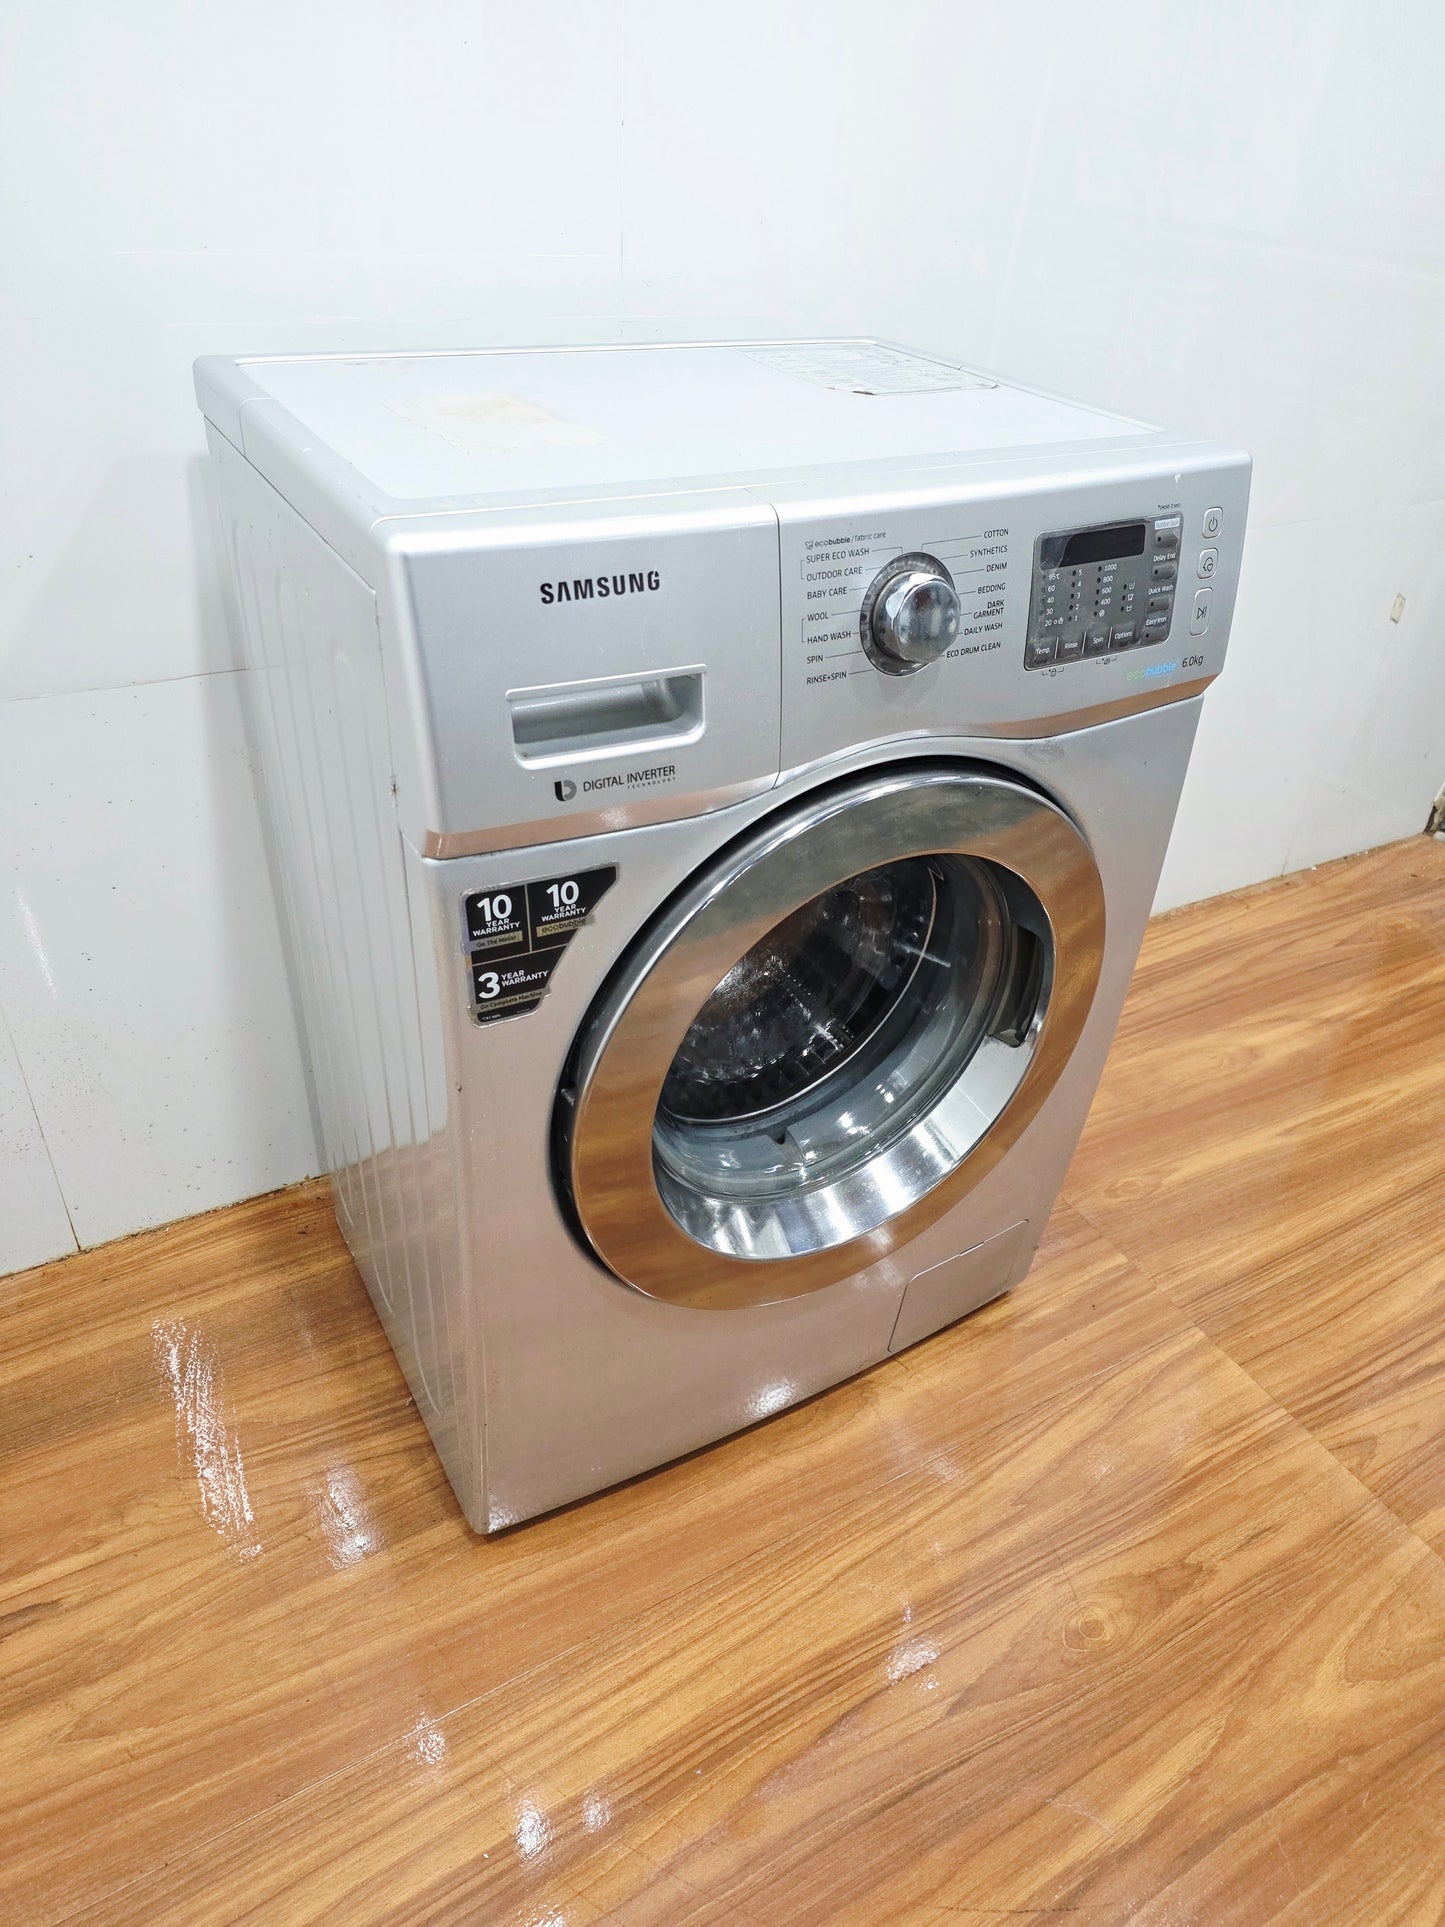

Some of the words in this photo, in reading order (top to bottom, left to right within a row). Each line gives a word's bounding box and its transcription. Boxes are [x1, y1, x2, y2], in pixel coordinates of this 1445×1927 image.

[983, 528, 1009, 539] COTTON
[806, 552, 830, 564] SUPER
[832, 550, 847, 560] ECO
[848, 547, 870, 558] WASH
[970, 545, 1008, 558] SYNTHETICS
[1153, 554, 1166, 562] Delay
[1167, 552, 1176, 560] End
[806, 569, 843, 581] OUTDOOR
[844, 566, 863, 577] CARE
[986, 562, 1008, 572] DENIM
[1104, 563, 1118, 571] 1000
[1102, 575, 1113, 583] 800
[540, 570, 661, 605] SAMSUNG
[807, 589, 827, 600] BABY
[828, 586, 848, 597] CARE
[977, 583, 1006, 594] BEDDING
[1148, 586, 1161, 595] Quick
[1161, 584, 1174, 592] Wash
[987, 599, 1005, 609] DARK
[1046, 596, 1055, 604] 40
[807, 611, 829, 622] WOOL
[973, 607, 1004, 619] GARMENT
[1046, 608, 1054, 616] 30
[964, 625, 983, 636] DAILY
[984, 622, 1003, 632] WASH
[1114, 631, 1133, 640] Options
[807, 634, 829, 644] HAND
[830, 630, 852, 641] WASH
[946, 649, 959, 658] ECO
[960, 645, 980, 656] DRUM
[980, 641, 1001, 652] CLEAN
[806, 655, 824, 664] SPIN
[1126, 661, 1177, 680] ecobubble
[1181, 655, 1204, 668] 6.0kg
[583, 775, 624, 792] DIGITAL
[626, 765, 676, 784] INVERTER
[627, 776, 677, 789] TECHNOLOGY
[546, 880, 580, 907] 10
[476, 894, 513, 922] 10
[541, 906, 587, 922] WARRANTY
[554, 904, 577, 913] YEAR
[472, 921, 521, 937] WARRANTY
[486, 918, 511, 928] YEAR
[541, 917, 587, 933] ecobubble
[486, 938, 497, 946] The
[498, 934, 517, 943] Motor
[501, 969, 525, 980] YEAR
[501, 970, 549, 987] WARRANTY
[477, 971, 501, 999] 3
[489, 997, 518, 1008] Complete
[518, 991, 543, 1001] Machine
